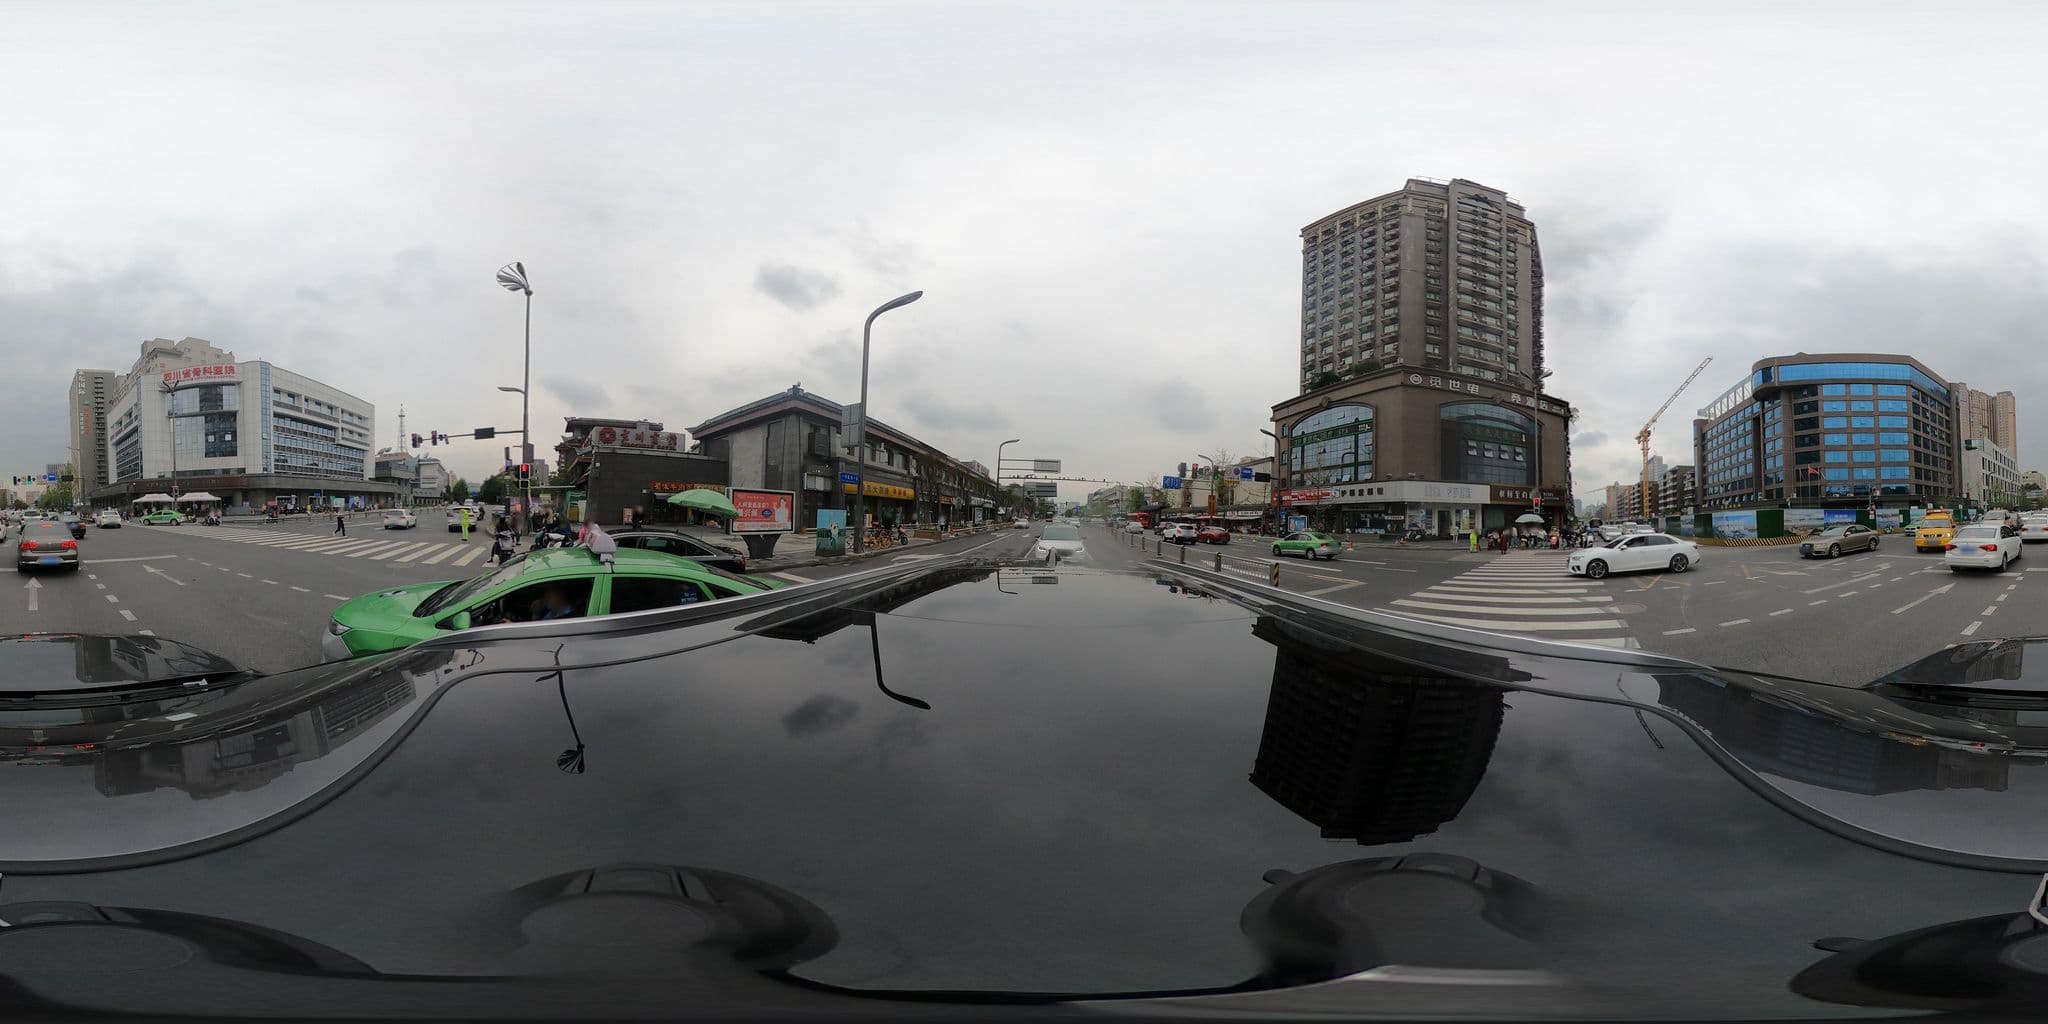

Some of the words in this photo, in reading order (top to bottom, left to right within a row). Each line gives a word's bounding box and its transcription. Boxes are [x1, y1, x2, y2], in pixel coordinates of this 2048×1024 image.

[163, 365, 236, 381] 四川省骨科医院
